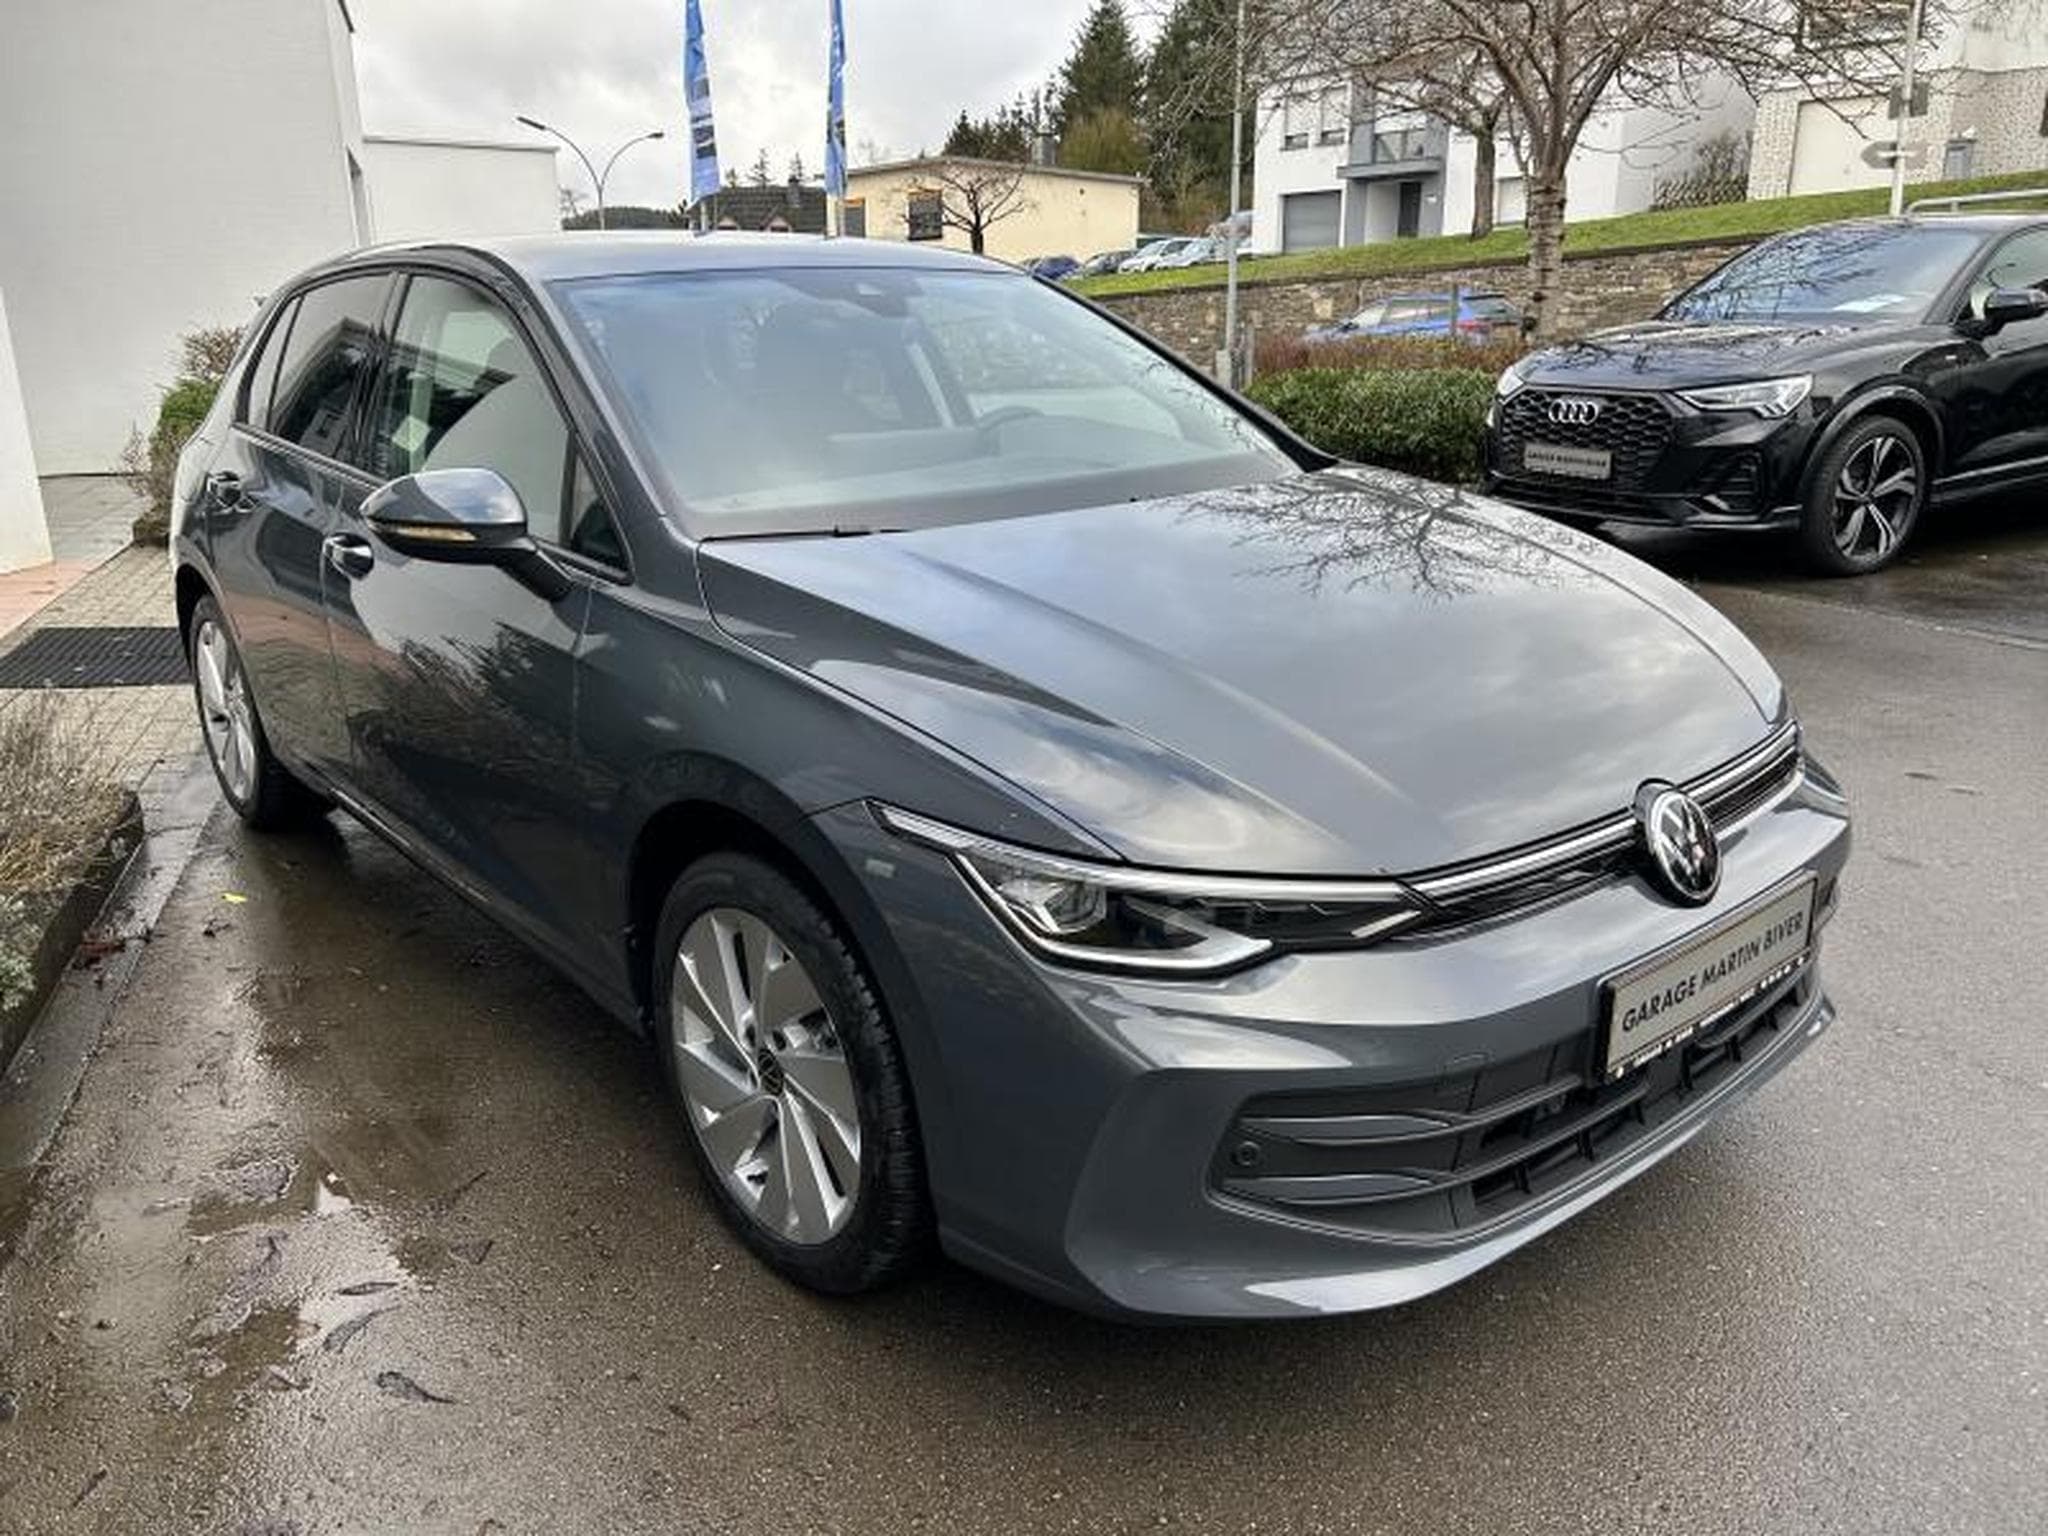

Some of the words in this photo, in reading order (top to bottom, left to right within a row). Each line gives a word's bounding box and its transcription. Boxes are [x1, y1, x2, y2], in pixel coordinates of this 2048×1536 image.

[1621, 974, 1698, 1033] GARAGE
[1701, 938, 1761, 987] MARTIN
[1761, 910, 1804, 952] BIVER
